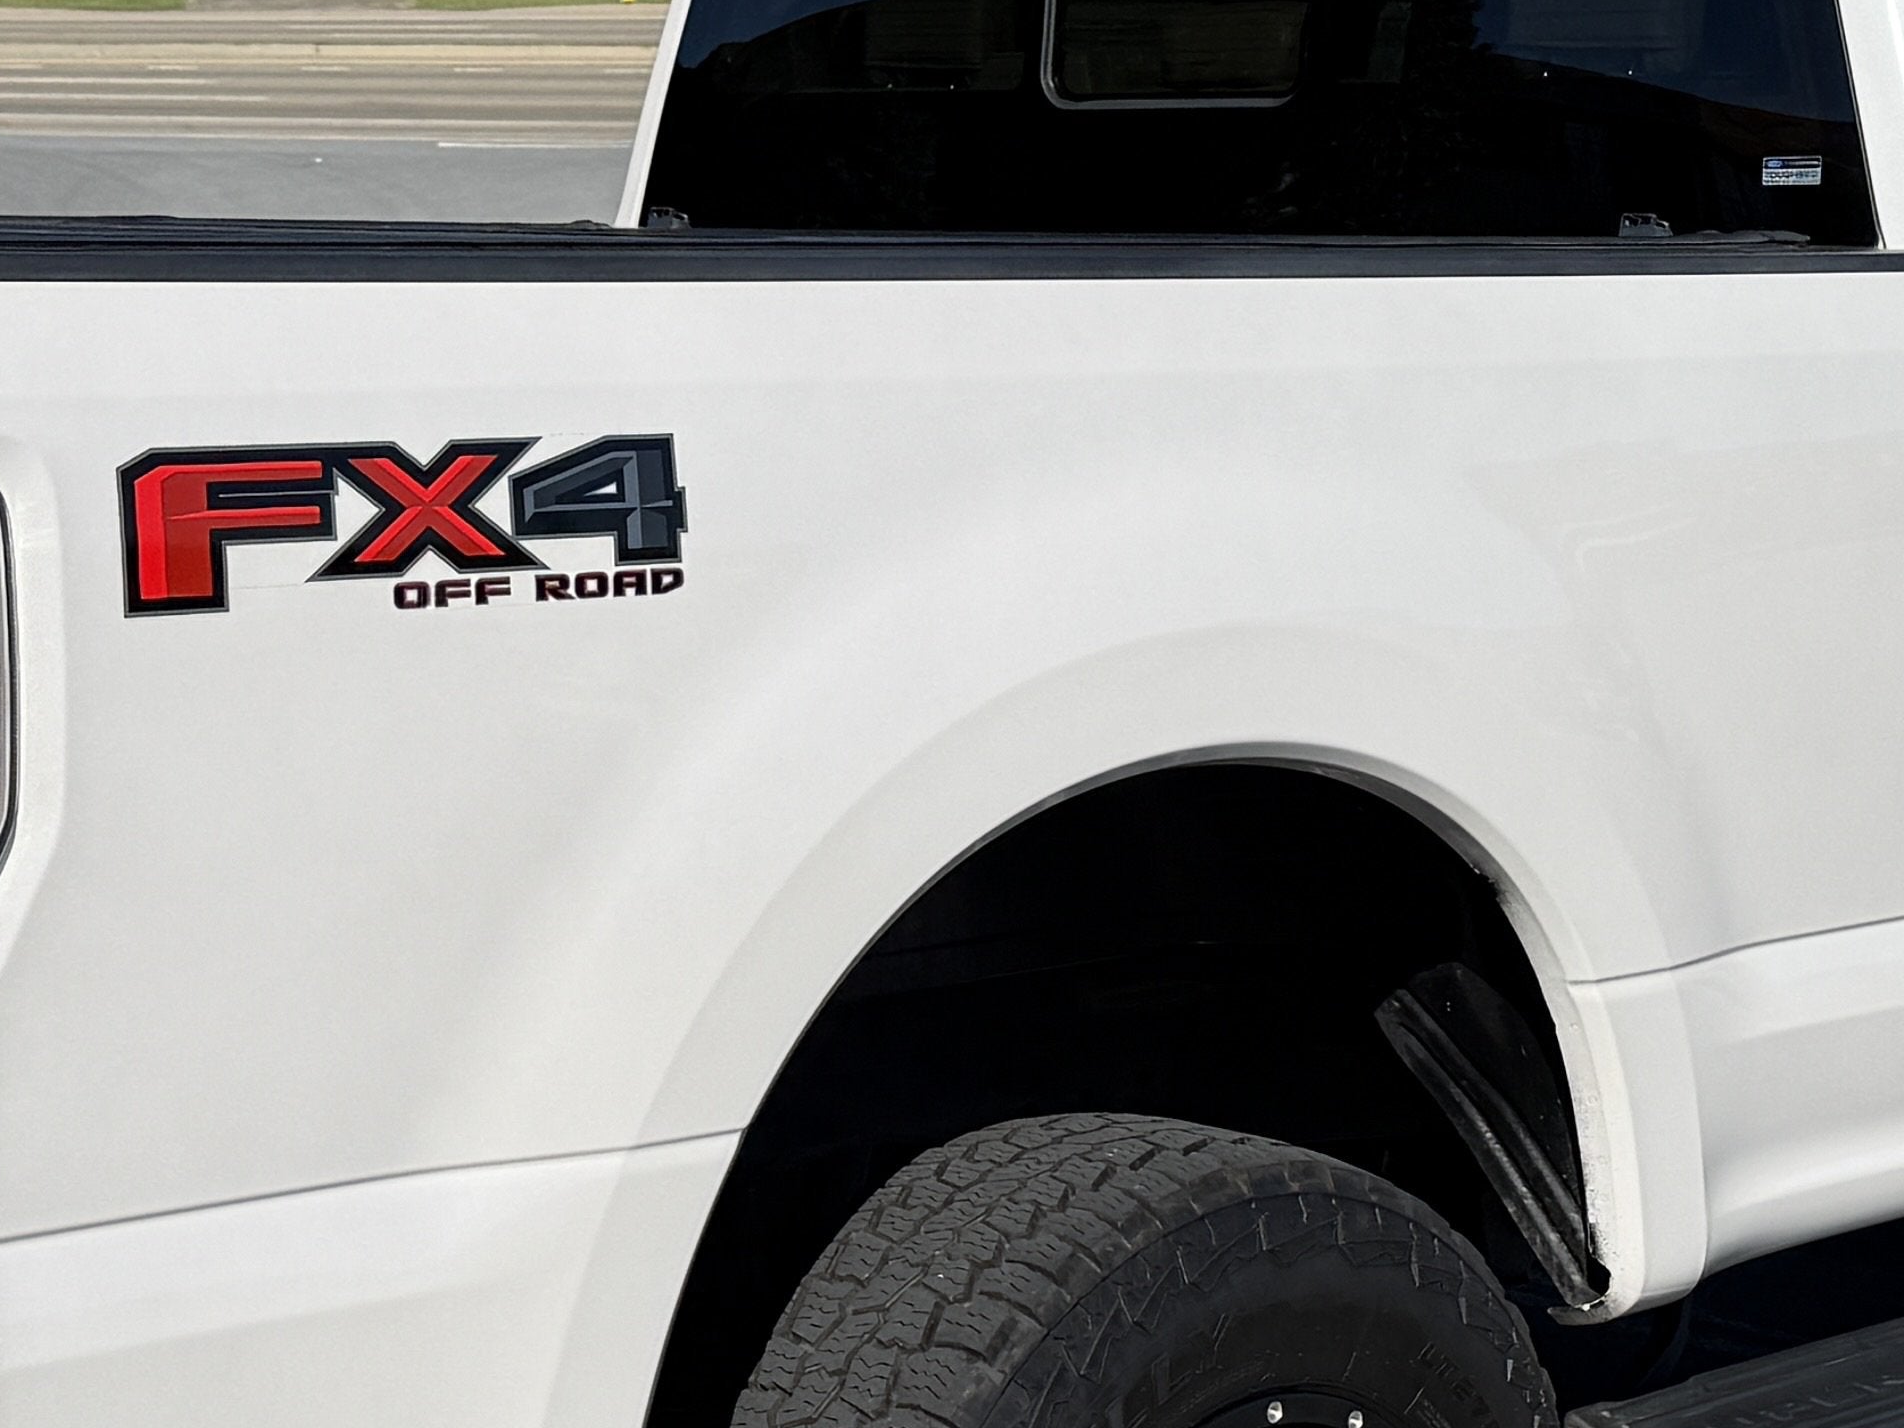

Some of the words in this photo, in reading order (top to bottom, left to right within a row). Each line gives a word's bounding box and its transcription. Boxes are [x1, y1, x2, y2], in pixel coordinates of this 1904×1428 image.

[117, 433, 688, 618] FX4
[393, 574, 512, 610] OFF
[535, 568, 685, 603] ROAD
